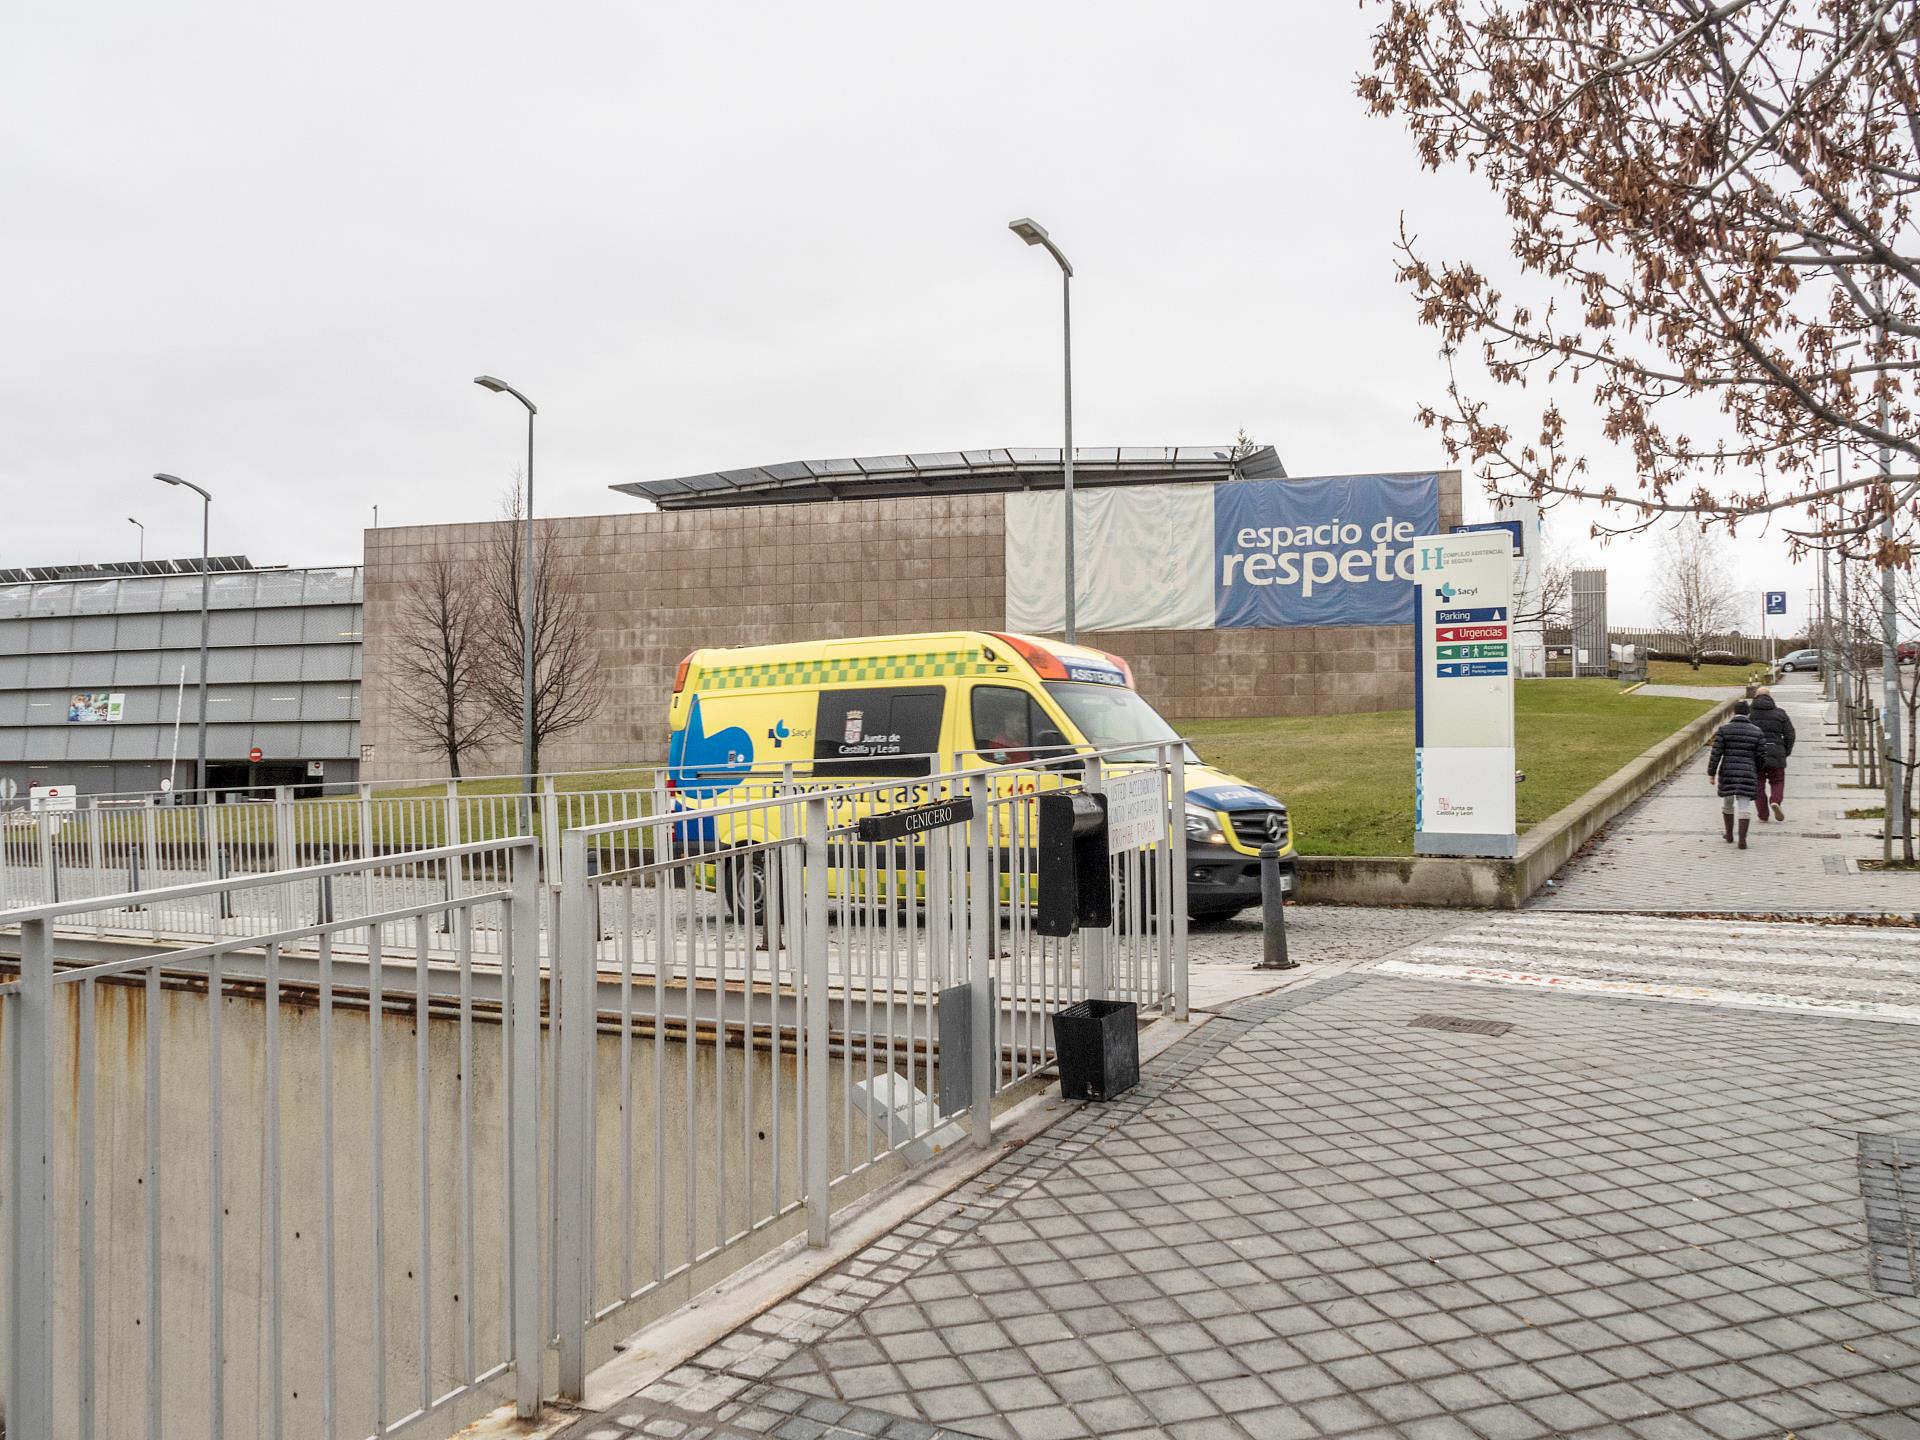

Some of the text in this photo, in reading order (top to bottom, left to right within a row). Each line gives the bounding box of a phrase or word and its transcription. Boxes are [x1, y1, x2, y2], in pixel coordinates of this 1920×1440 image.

[1237, 516, 1415, 554] espacio de
[1222, 543, 1415, 597] respeto
[1457, 587, 1478, 598] Sacyl
[1771, 595, 1782, 606] P
[1440, 612, 1471, 621] Parking
[1459, 628, 1503, 640] Urgencias
[791, 727, 812, 738] Sacyl
[862, 733, 901, 743] Junta de
[839, 744, 900, 756] Castilla y León
[1008, 783, 1035, 804] 112
[905, 807, 952, 831] CENICERO
